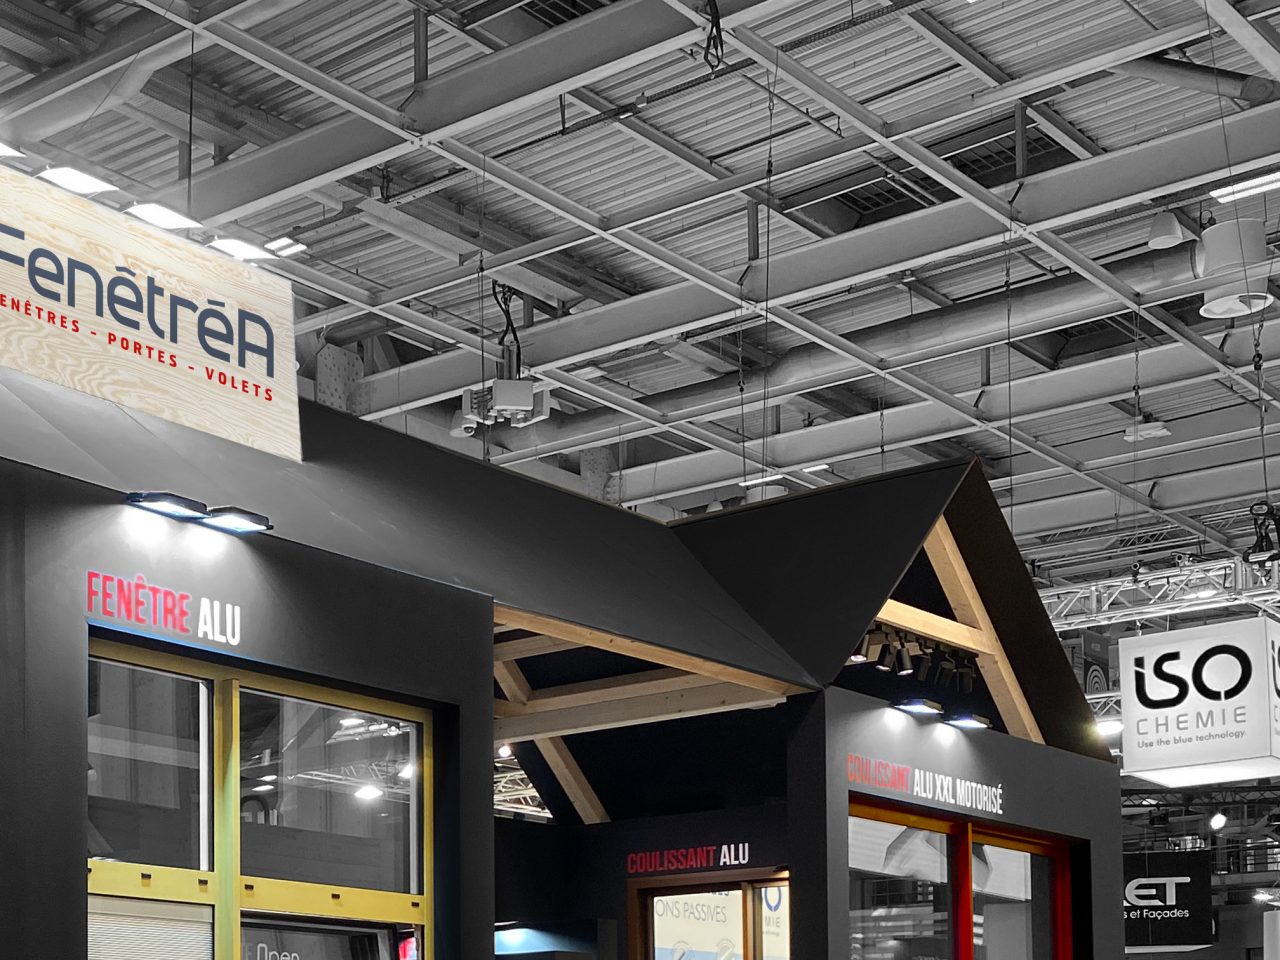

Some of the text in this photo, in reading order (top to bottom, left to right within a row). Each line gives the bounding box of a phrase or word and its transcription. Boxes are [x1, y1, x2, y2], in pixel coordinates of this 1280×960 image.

[107, 333, 178, 369] PORTES
[205, 366, 274, 403] VOLETS
[86, 570, 241, 645] FENÊTRE ALU
[1136, 706, 1247, 735] CHEMIE
[1137, 740, 1154, 749] Use
[1156, 738, 1171, 747] the
[1173, 735, 1193, 745] blue
[847, 752, 1003, 815] COULISSANT ALU XXL MOTORISÉ
[627, 842, 749, 874] COULISSANT ALU
[1129, 909, 1140, 919] et
[1143, 908, 1190, 920] Façades
